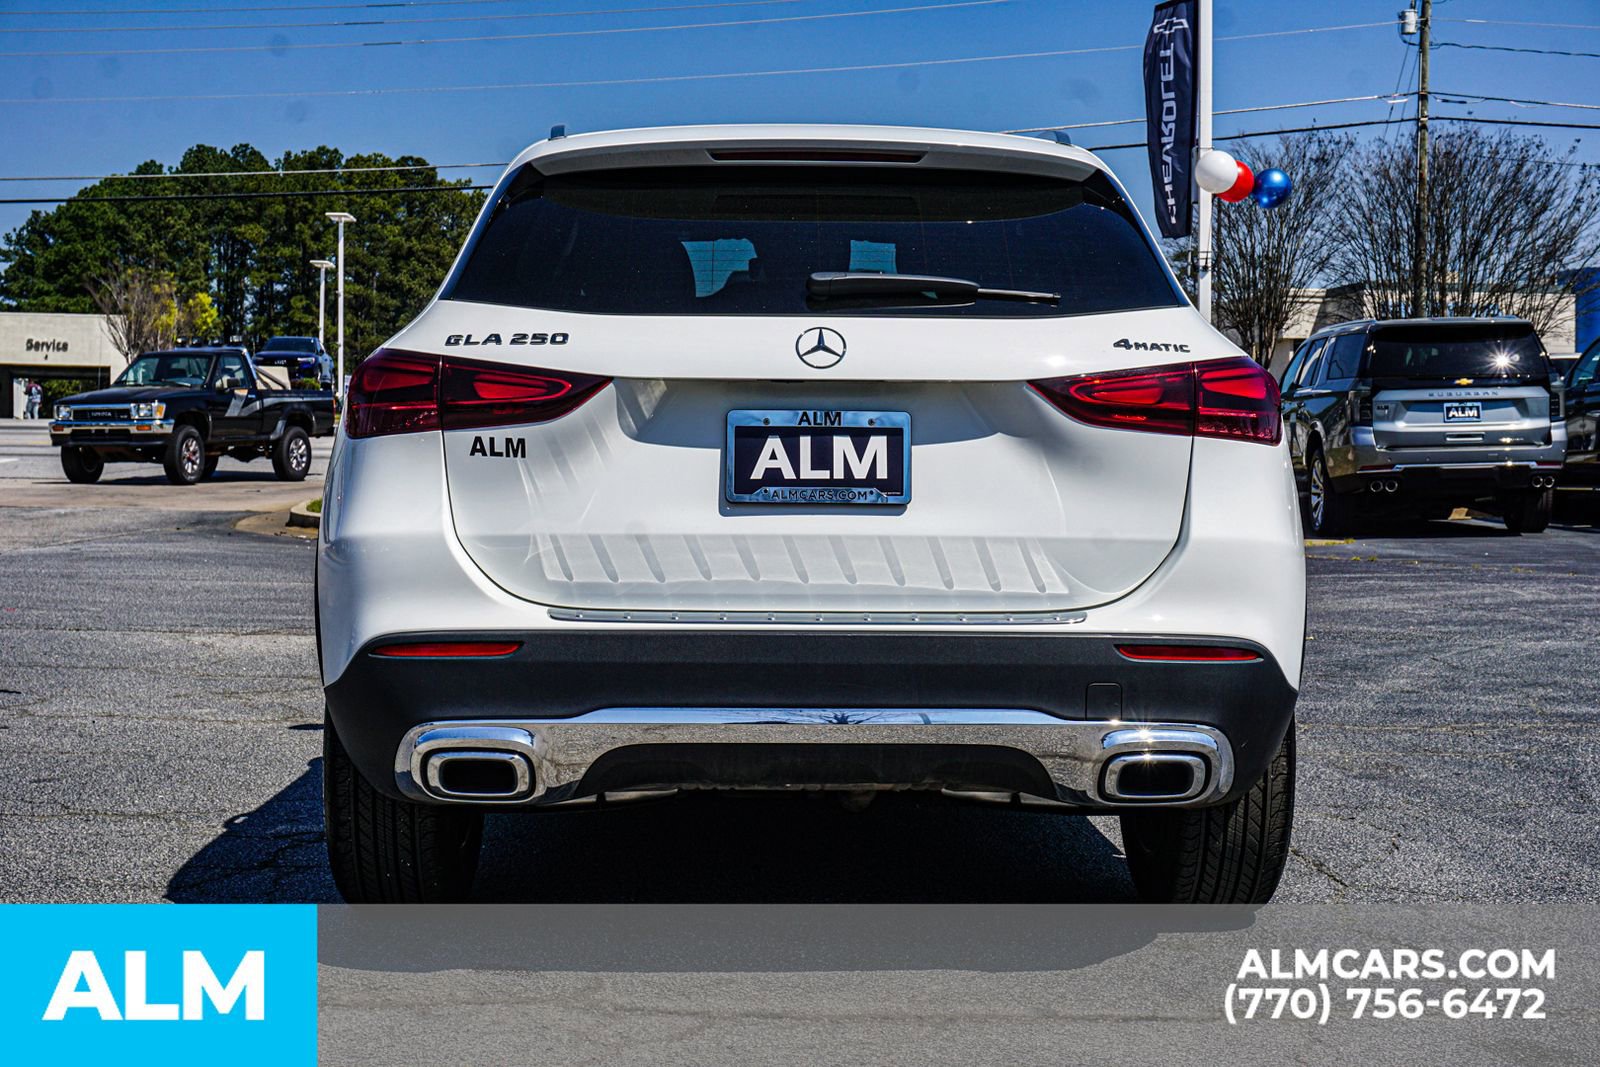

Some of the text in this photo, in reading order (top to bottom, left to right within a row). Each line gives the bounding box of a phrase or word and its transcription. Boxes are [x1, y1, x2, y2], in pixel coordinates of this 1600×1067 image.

[26, 338, 68, 352] Service
[444, 332, 569, 346] GLA 250
[1113, 338, 1190, 353] 4MATIC
[798, 411, 842, 426] ALM
[1448, 407, 1478, 417] ALM
[469, 436, 526, 458] ALM
[750, 435, 888, 480] ALM
[771, 490, 868, 501] ALMCARS.COM
